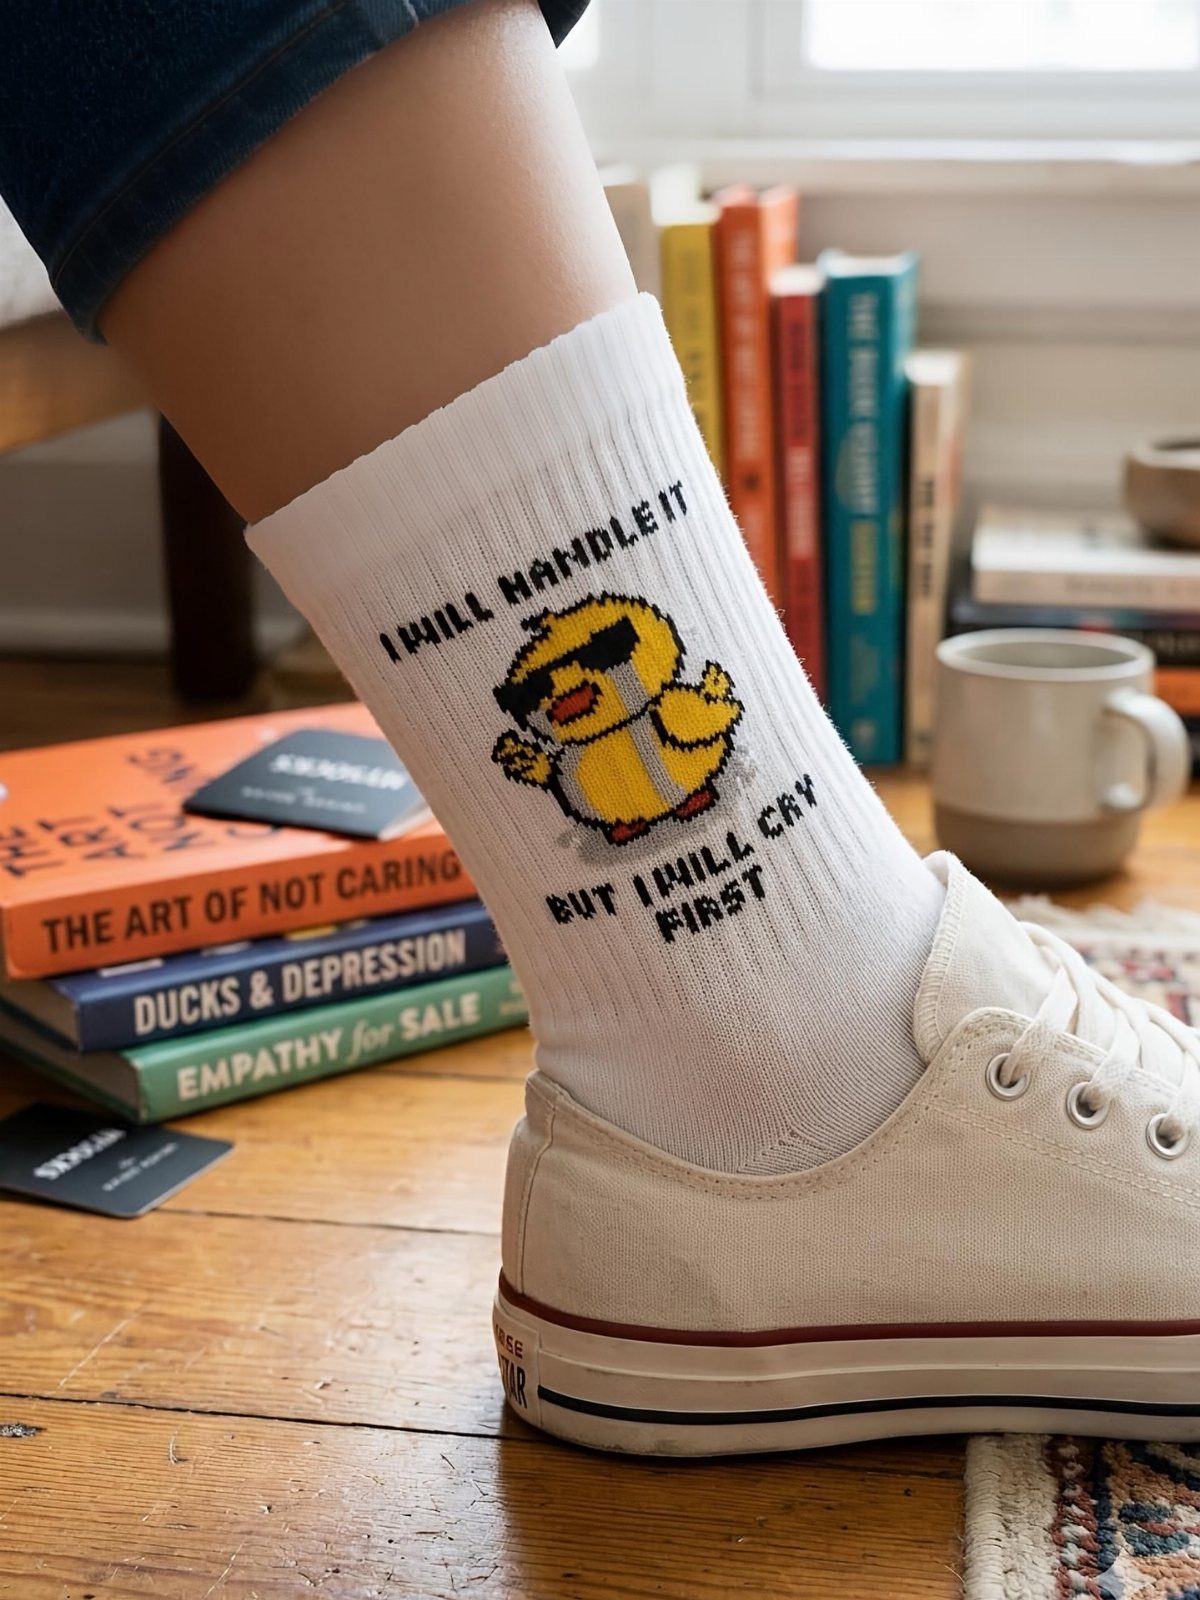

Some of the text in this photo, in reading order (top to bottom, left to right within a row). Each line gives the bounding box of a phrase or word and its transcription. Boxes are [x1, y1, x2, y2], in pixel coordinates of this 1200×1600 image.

[379, 480, 687, 665] I WILL HANDLE IT
[42, 850, 461, 953] THE ART OF NOT CARING
[546, 773, 818, 924] BUT I WILL CRY
[655, 864, 766, 943] FIRST
[134, 929, 466, 1036] DUCKS & DEPRESSION
[176, 992, 481, 1101] EMPATHY for SALE
